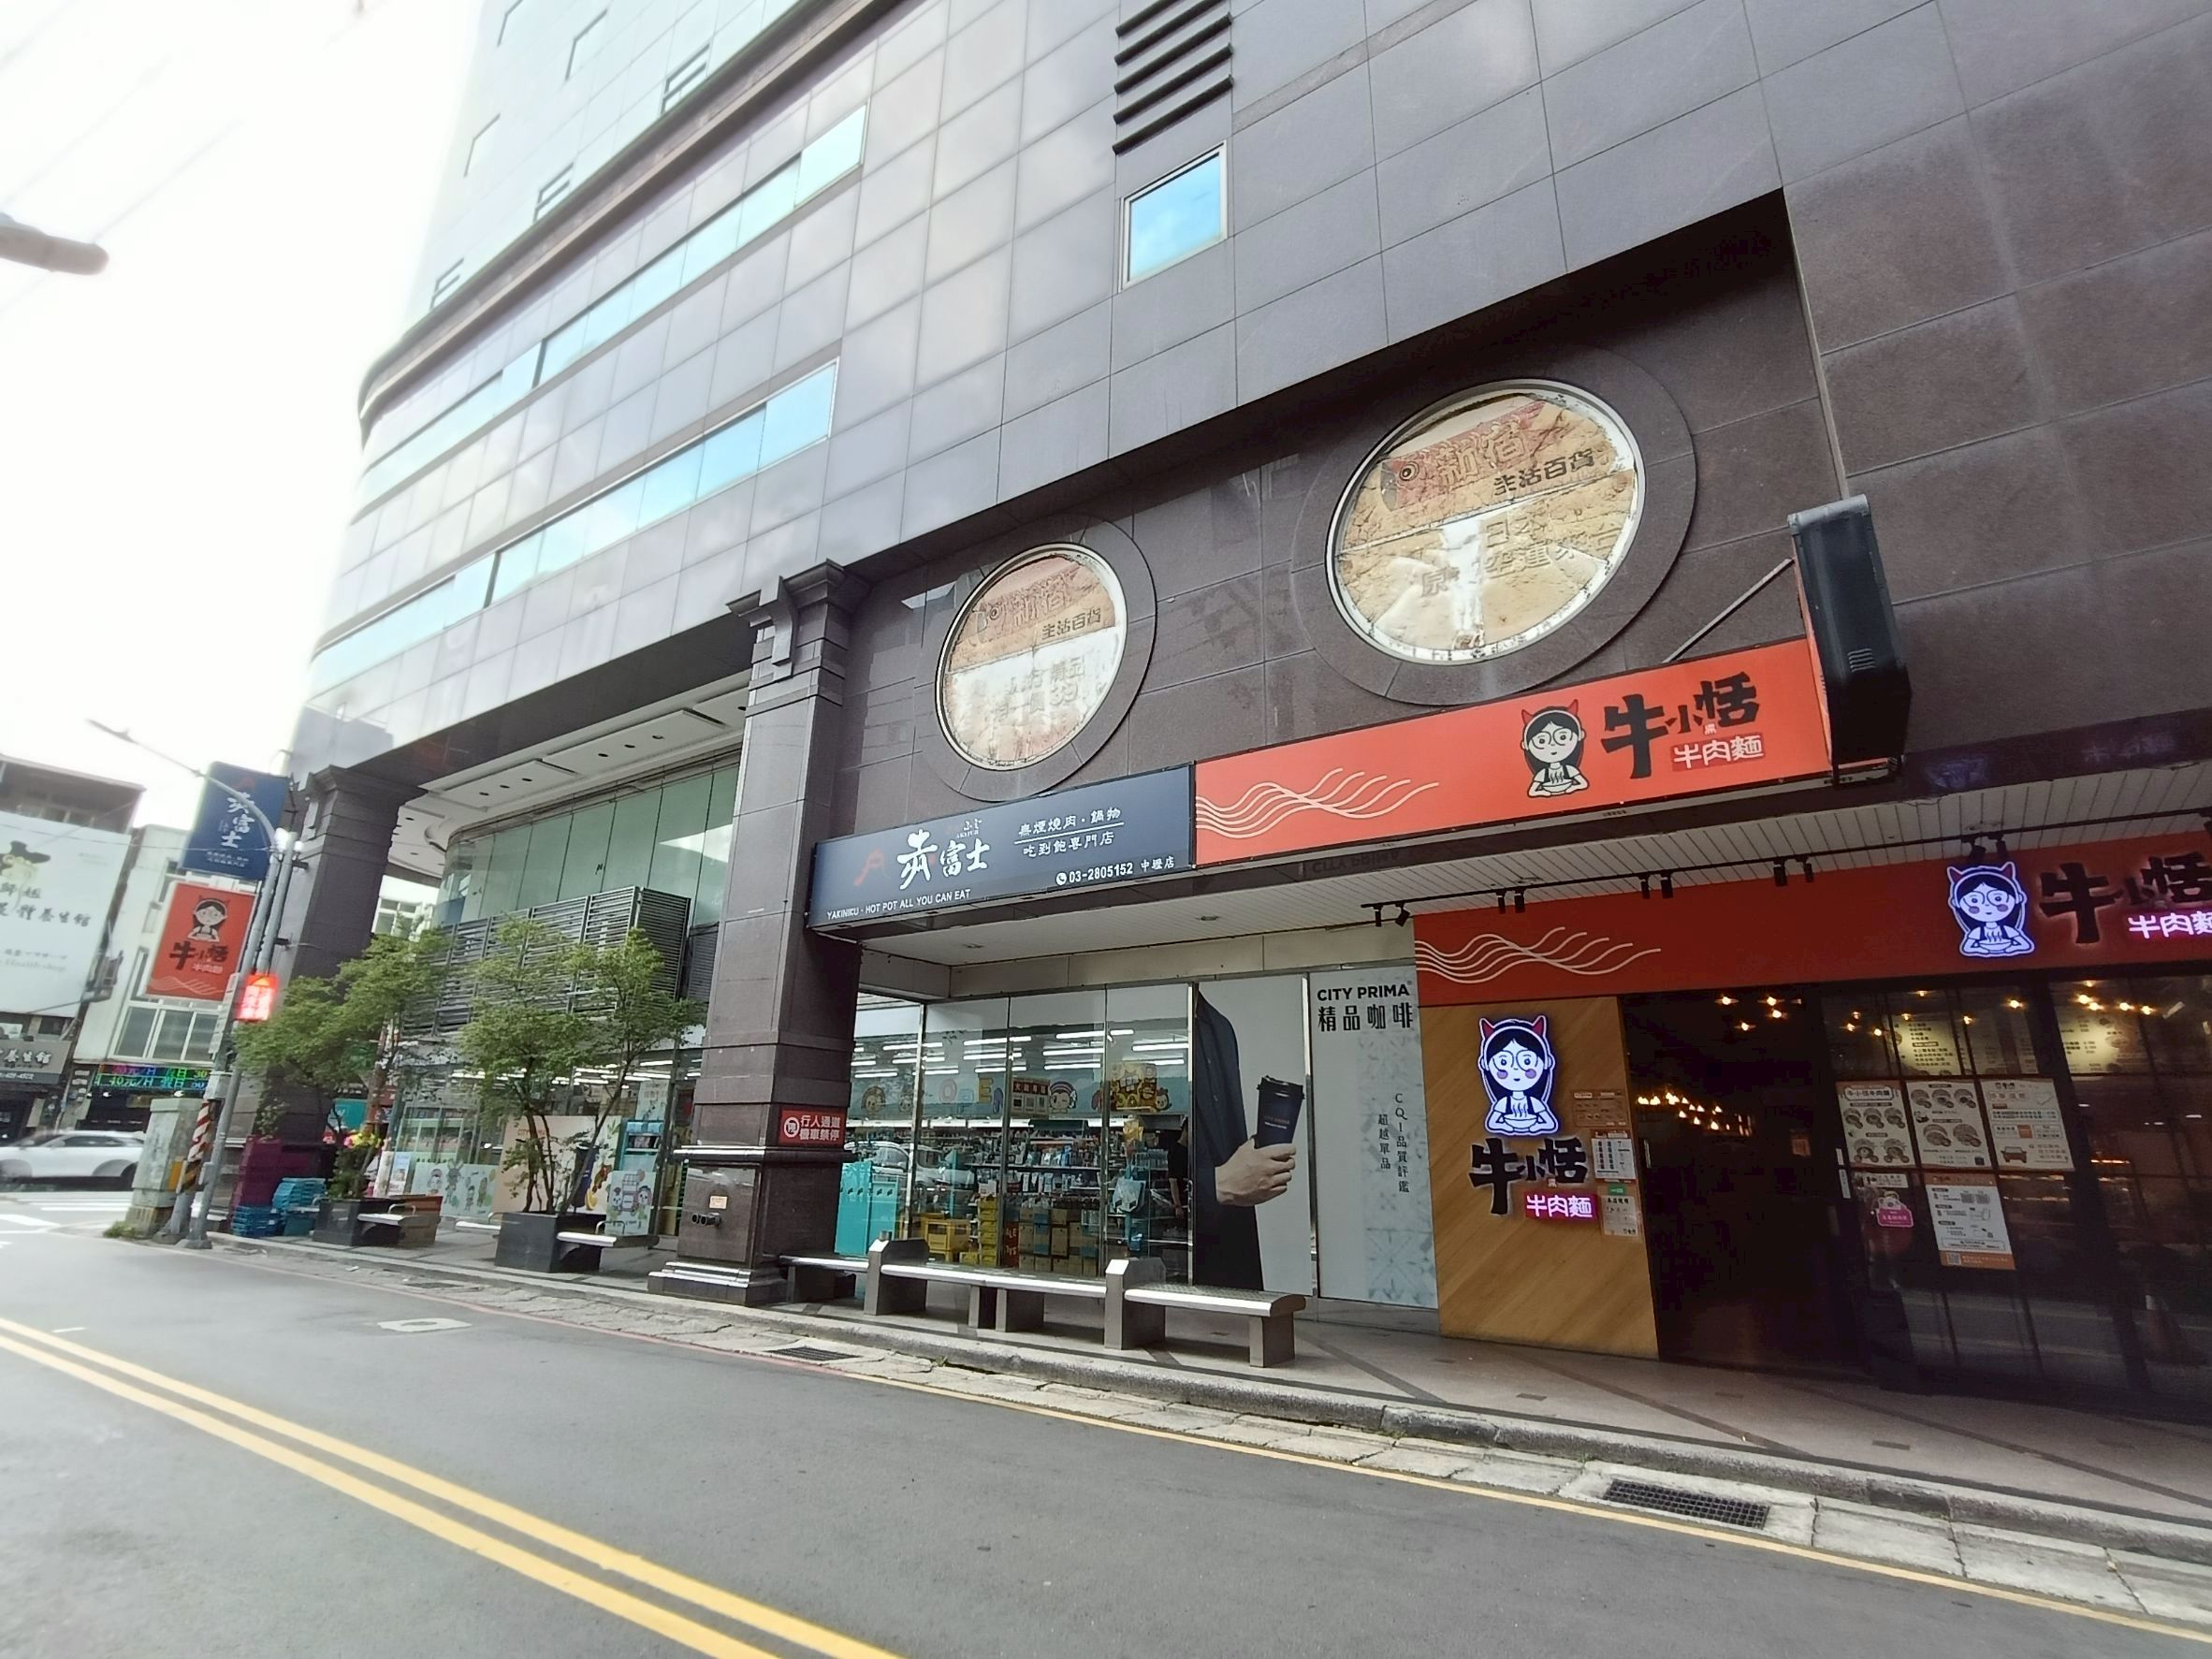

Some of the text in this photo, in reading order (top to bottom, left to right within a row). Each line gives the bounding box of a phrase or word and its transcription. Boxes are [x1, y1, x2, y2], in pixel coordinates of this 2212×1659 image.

[1601, 672, 1760, 779] 牛小恬
[1673, 735, 1764, 769] 牛肉麵
[1069, 862, 1133, 883] 03-2805152
[826, 889, 971, 920] YAKINIKU HOT POT ALL YOU CAN EAT
[1317, 983, 1410, 1001] CITY PRIMA
[1317, 1002, 1414, 1032] 精品咖啡
[1377, 1113, 1391, 1170] 超越單品
[1469, 1137, 1588, 1215] 牛小恬
[1526, 1194, 1593, 1217] 牛肉麵
